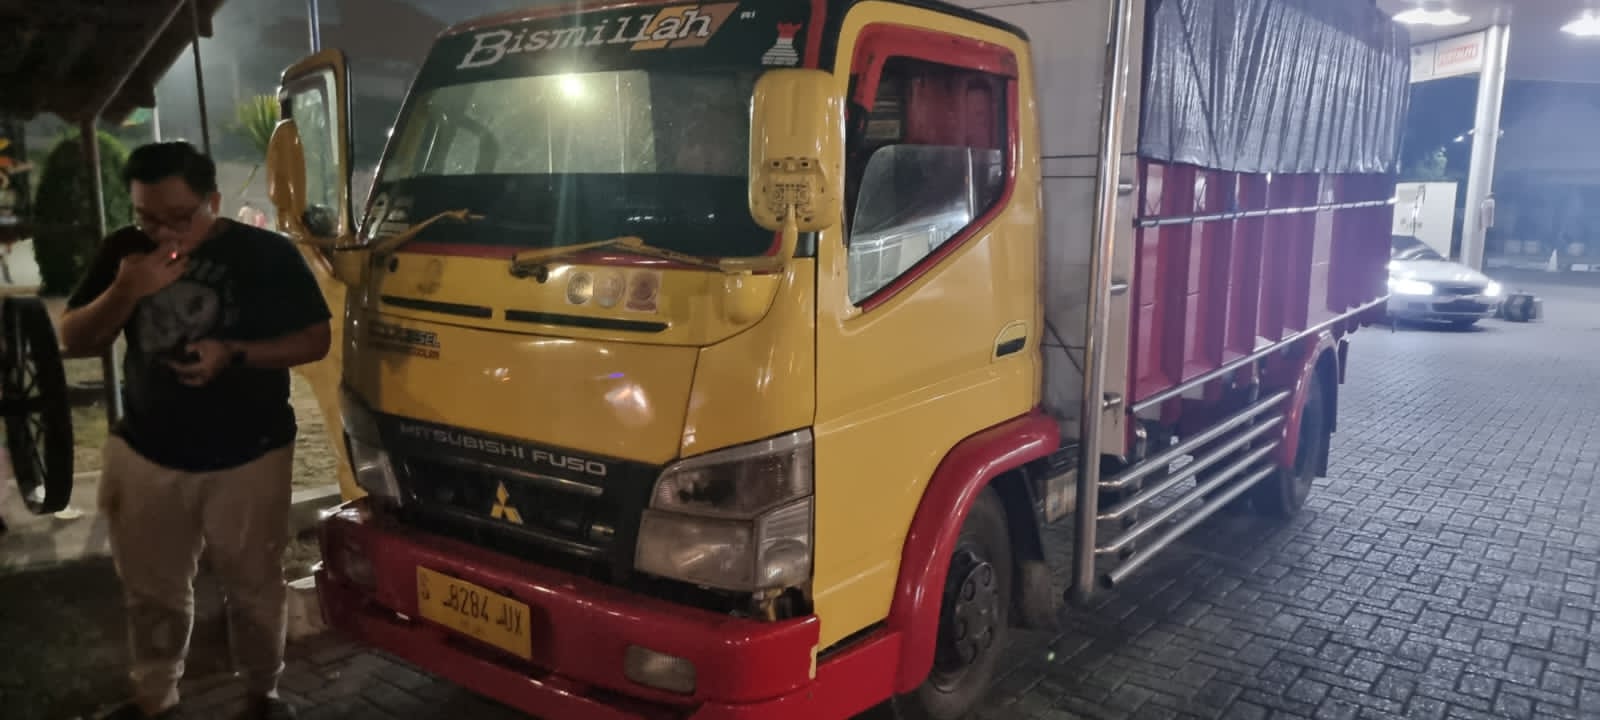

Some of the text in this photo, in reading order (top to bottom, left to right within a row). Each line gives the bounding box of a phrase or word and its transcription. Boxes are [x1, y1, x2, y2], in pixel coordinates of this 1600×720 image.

[456, 9, 712, 70] Bismillah
[401, 423, 608, 477] MITSUBISHI FUSO
[448, 583, 490, 622] 8284
